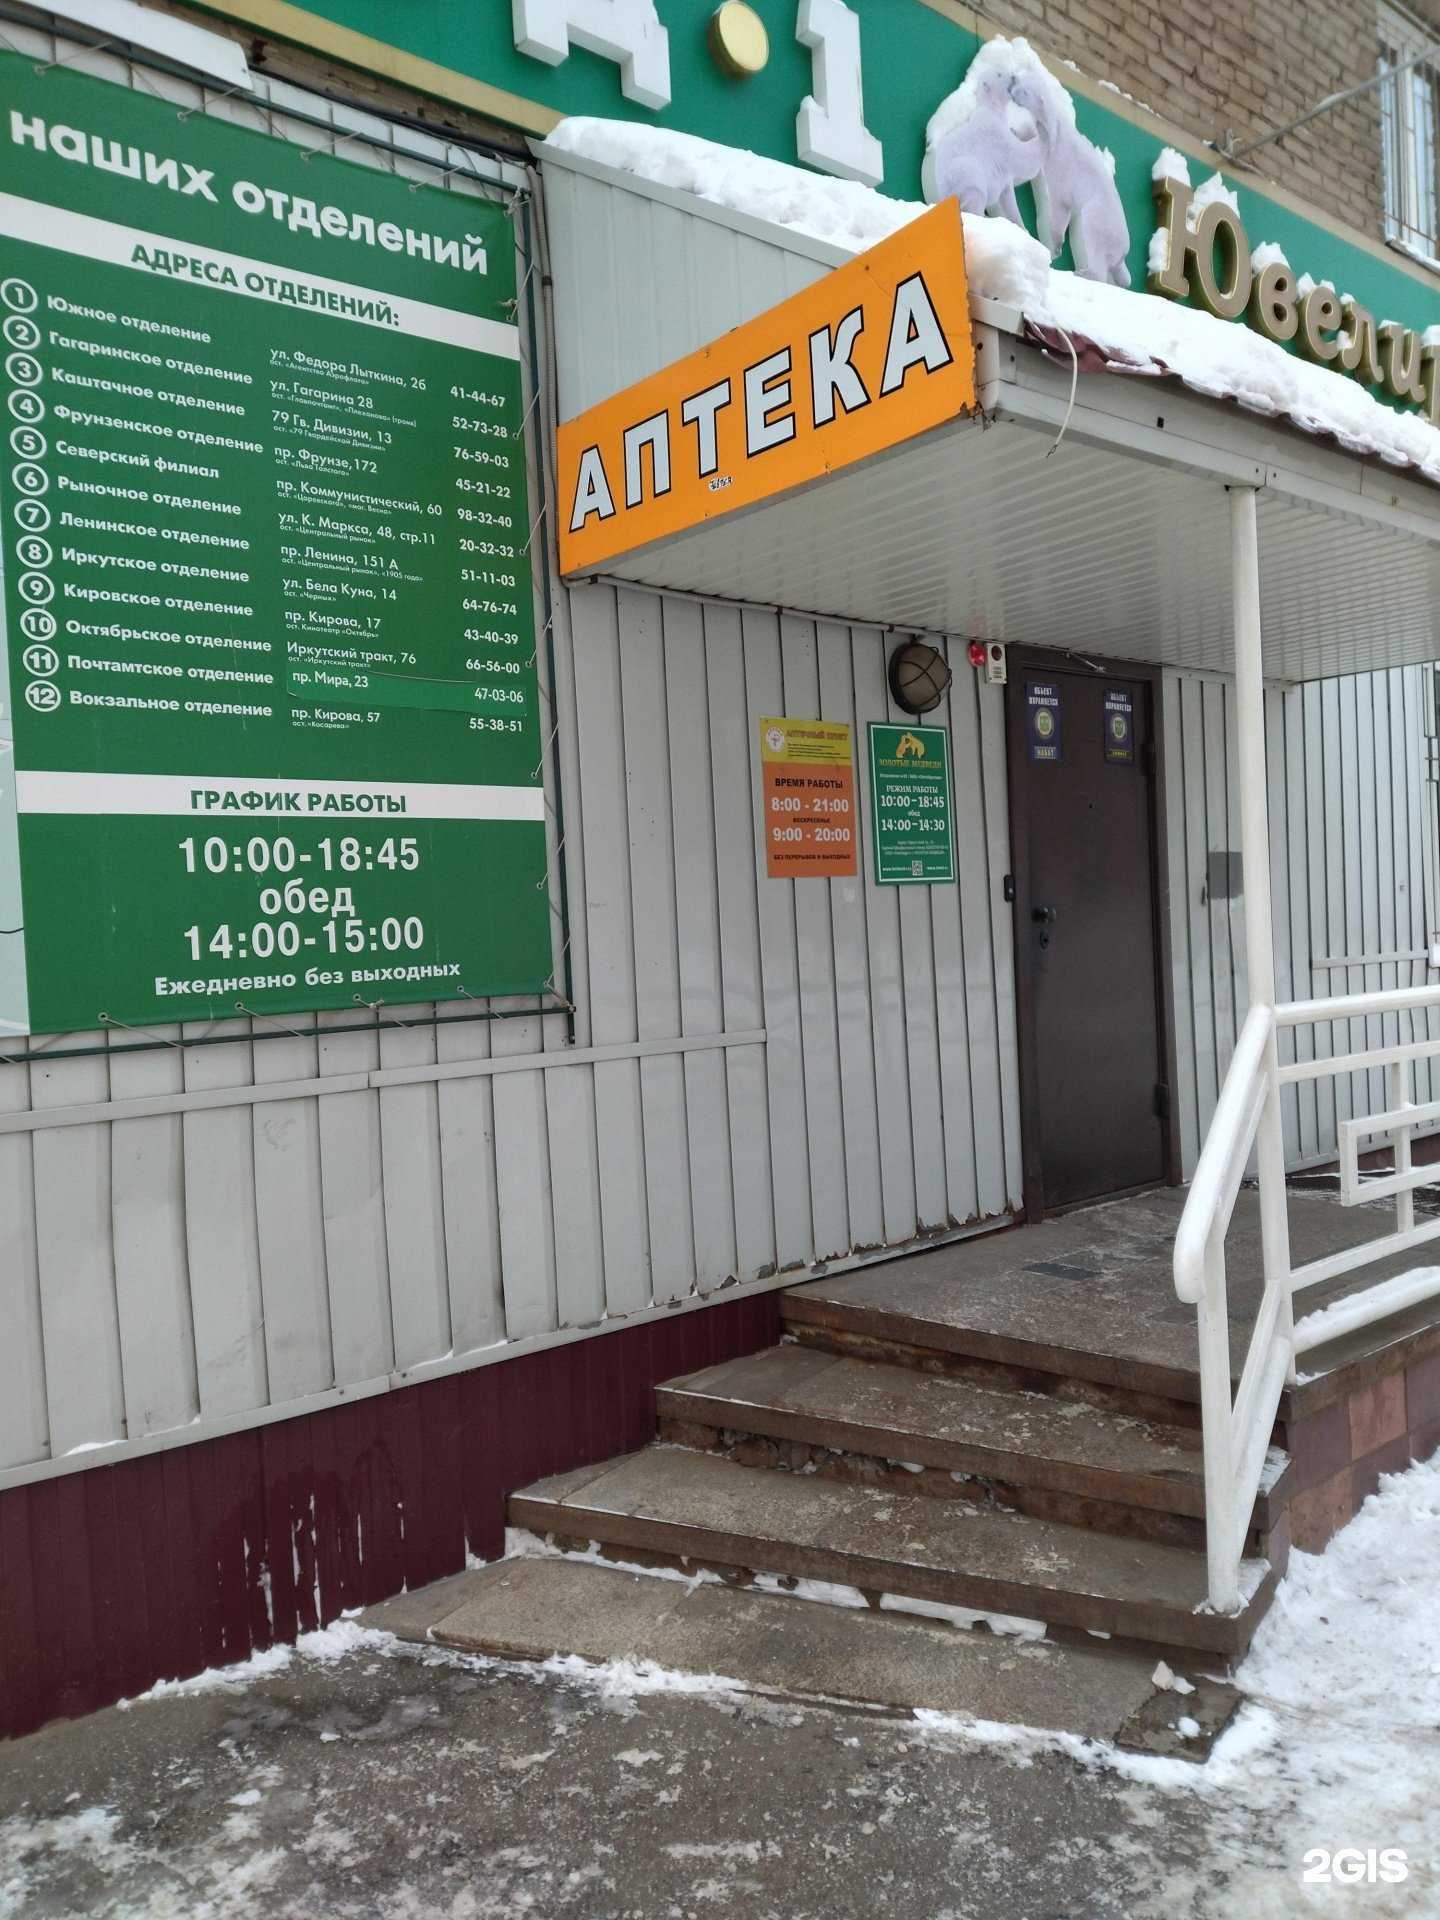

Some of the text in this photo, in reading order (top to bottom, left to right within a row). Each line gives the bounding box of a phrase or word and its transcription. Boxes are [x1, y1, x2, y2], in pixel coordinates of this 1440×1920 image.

[10, 110, 488, 276] наших отделений
[131, 244, 399, 327] АДРЕСА ОТДЕЛЕНИЙ:
[15, 287, 211, 343] 1 Южное отделение
[15, 324, 253, 384] 2 Гагаринское отделение
[271, 348, 426, 390] ул. Федора Лыткина, 26
[18, 361, 245, 416] 3 Каштачное отделение
[270, 381, 373, 409] ул. Гагарина 28
[450, 385, 505, 407] 41-44-67
[569, 270, 954, 534] АПТЕКА
[20, 399, 263, 453] 4 Фрунзенское отделение
[272, 410, 392, 444] 79 Гв. Дивизии, 13
[452, 416, 507, 438] 52-73-28
[22, 436, 219, 479] 5 Северский филиал
[275, 448, 294, 459] пр.
[454, 447, 509, 468] 76-59-03
[24, 472, 241, 515] 6 Рыночное отделение
[277, 480, 442, 515] пр. Коммунистический, 60
[456, 478, 511, 499] 45-21-22
[26, 508, 249, 550] 7 Ленинское отделение
[278, 513, 298, 524] ул.
[302, 514, 315, 526] К.
[319, 516, 373, 536] Маркса,
[377, 526, 396, 540] 48,
[458, 508, 512, 528] 98-32-40
[281, 546, 398, 570] пр. Ленина, 151 А
[459, 539, 514, 558] 20-32-32
[28, 544, 249, 582] 8 Иркутское отделение
[283, 578, 397, 600] ул. Бела Куна, 14
[461, 569, 516, 587] 51-11-03
[30, 580, 253, 616] 9 Кировское отделение
[462, 599, 518, 615] 64-76-74
[27, 616, 271, 651] 10 Октябрьское отделение
[285, 611, 381, 629] пр. Кирова, 17
[464, 629, 518, 645] 43-40-39
[288, 641, 417, 664] Иркутский тракт, 76
[29, 652, 273, 684] 11 Почтамтское отделение
[293, 671, 368, 688] пр. Мира, 23
[466, 659, 520, 674] 66-56-00
[29, 688, 272, 717] 12 Вокзальное отделение
[475, 688, 524, 703] 47-03-06
[292, 709, 381, 723] пр. Кирова, 57
[469, 718, 522, 732] 55-38-51
[775, 778, 843, 788] ВРЕМЯ РАБОТЫ
[190, 790, 407, 812] ГРАФИК РАБОТЫ
[771, 797, 800, 811] 8:00
[813, 799, 849, 812] 21:00
[773, 827, 802, 841] 9:00
[815, 828, 850, 841] 20:00
[178, 836, 420, 873] 10:00-18:45
[259, 877, 356, 917] обед
[184, 916, 424, 961] 14:00-15:00
[155, 962, 461, 996] Ежедневно без выходных
